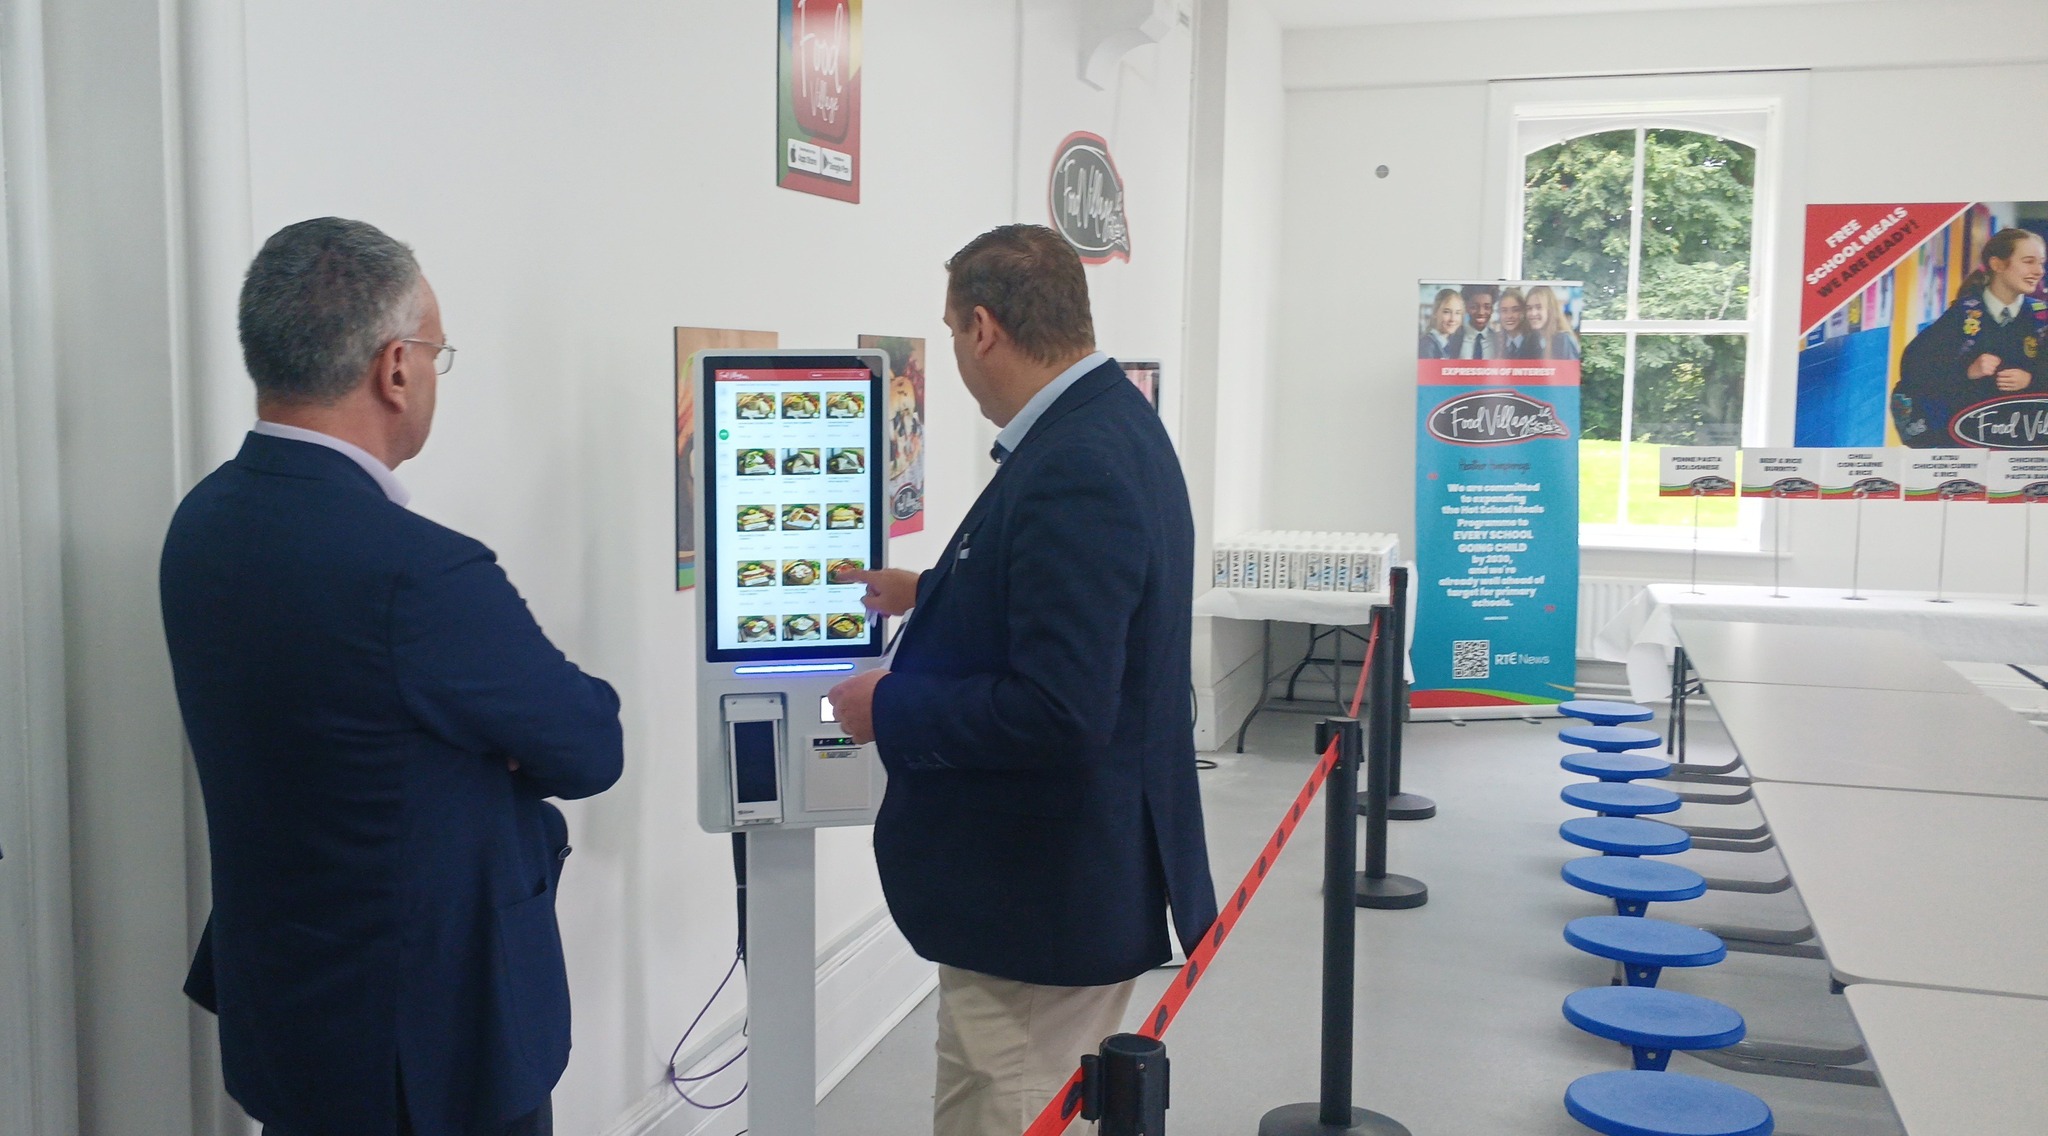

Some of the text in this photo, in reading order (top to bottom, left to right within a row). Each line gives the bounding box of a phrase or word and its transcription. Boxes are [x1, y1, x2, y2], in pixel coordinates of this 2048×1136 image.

[798, 0, 842, 97] Food
[810, 77, 839, 123] Village
[1825, 219, 1862, 248] FREE
[1805, 207, 1908, 285] SCHOOL MEALS
[1817, 219, 1920, 297] WE ARE READY!
[1441, 367, 1556, 376] EXPRESSION OF INTEREST
[1450, 406, 1485, 437] Food
[1485, 404, 1538, 437] Village
[1978, 411, 2020, 441] Food
[1447, 482, 1541, 492] We are committed
[1460, 493, 1526, 505] to expanding
[1441, 505, 1544, 514] the Hot School Meals
[1457, 518, 1529, 529] Programme to
[1453, 530, 1534, 540] EVERY SCHOOL
[1458, 543, 1528, 552] GOING CHILD
[1471, 555, 1485, 566] by
[1468, 565, 1488, 574] and
[1438, 575, 1545, 588] already well ahead of
[1446, 586, 1537, 599] target for primary
[1471, 598, 1514, 607] schools.
[1494, 652, 1550, 665] RTÉ News
